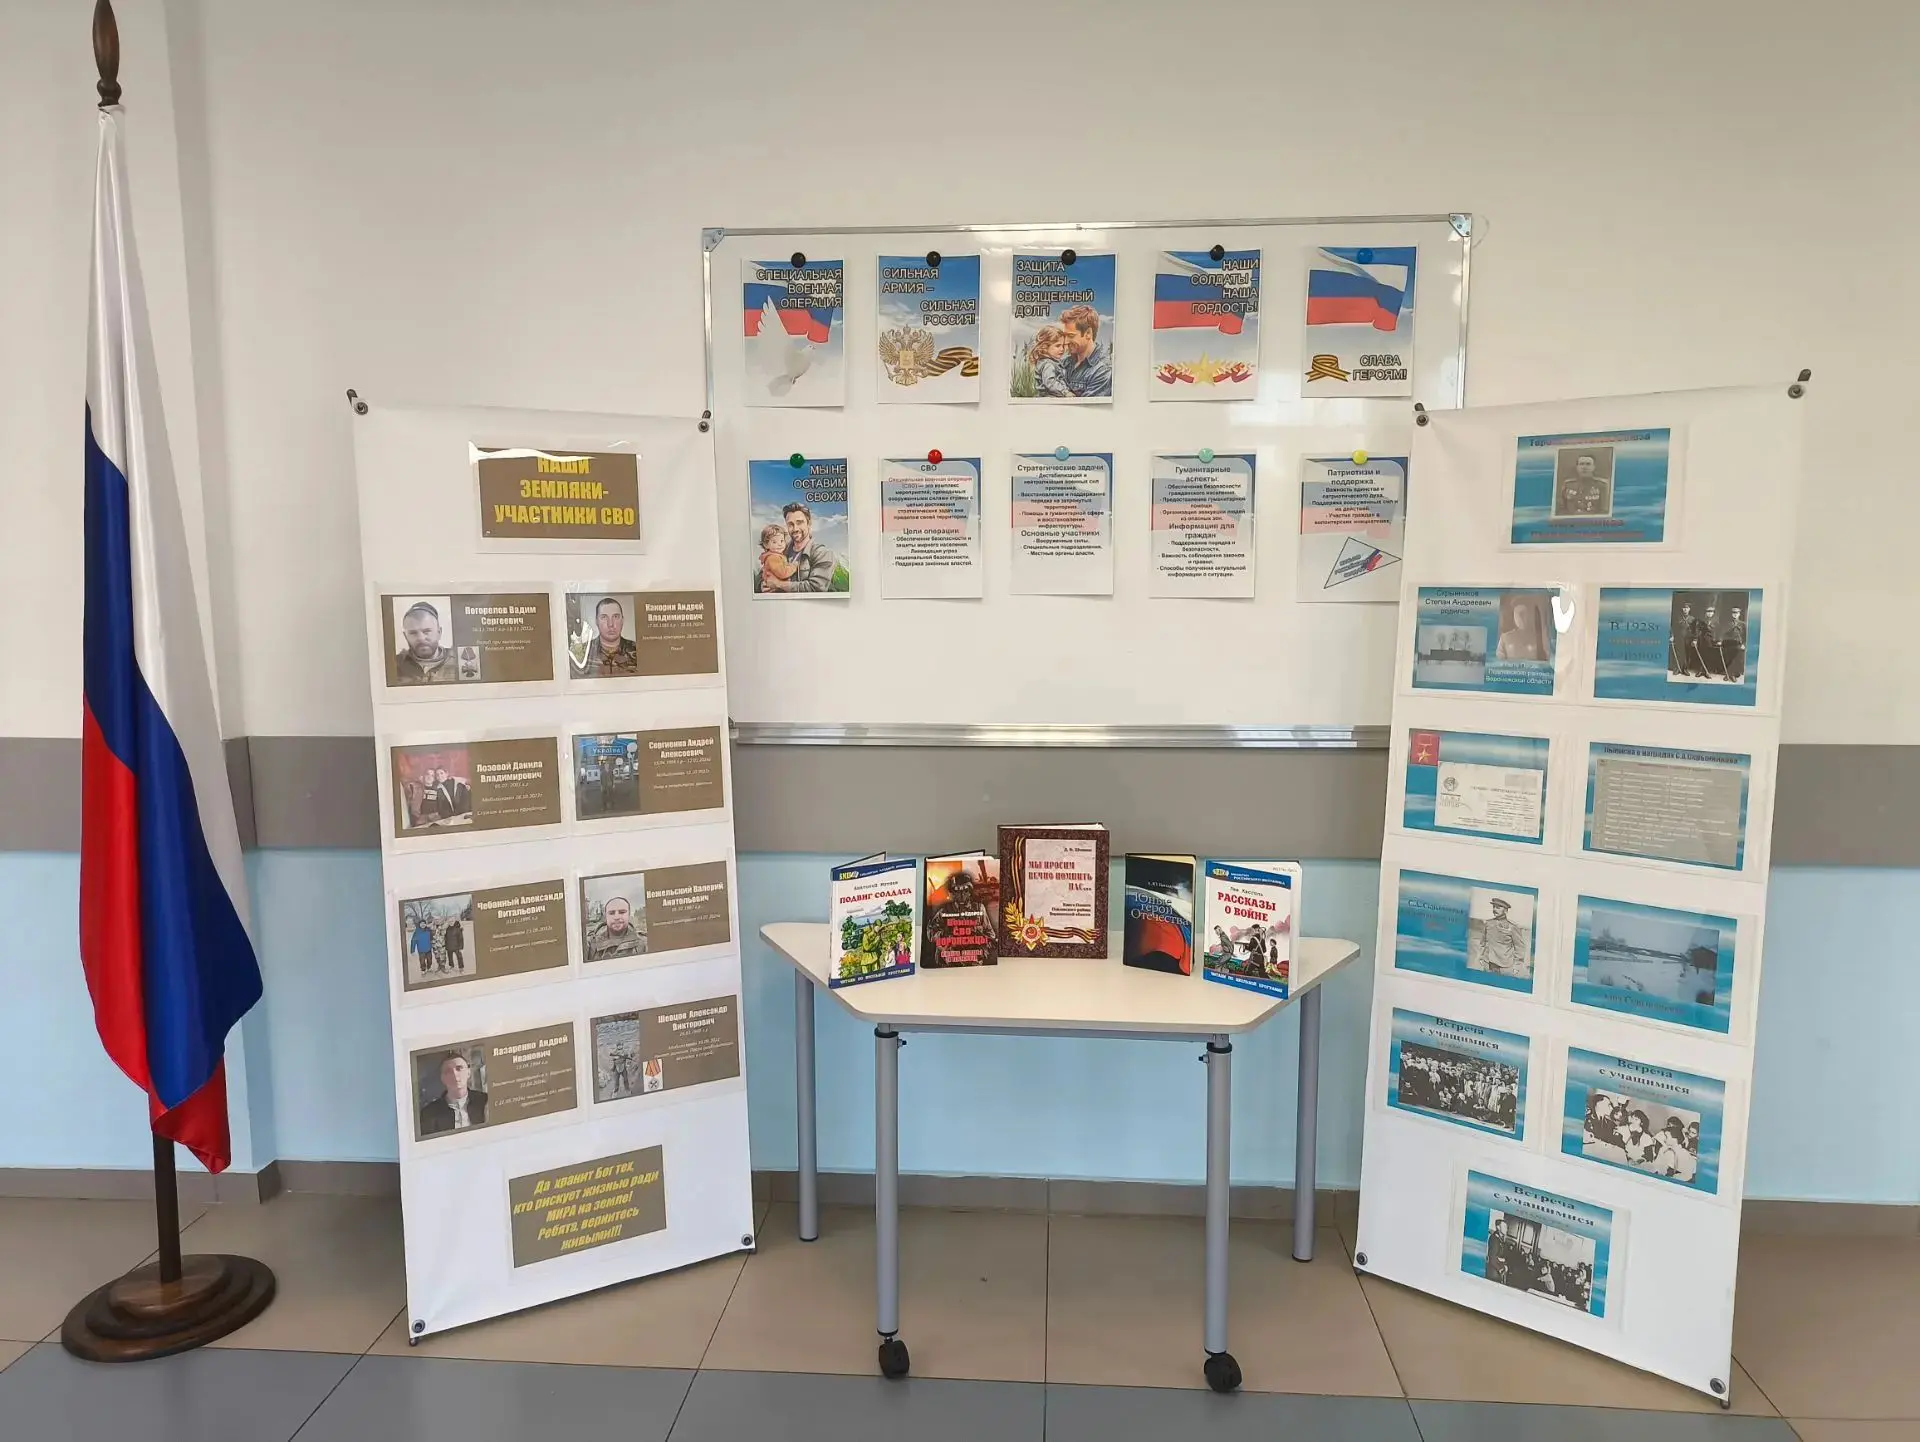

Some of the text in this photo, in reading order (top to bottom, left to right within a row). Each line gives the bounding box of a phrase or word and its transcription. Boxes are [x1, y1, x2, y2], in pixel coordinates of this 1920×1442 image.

[1017, 261, 1065, 273] ЗАЩИТА
[1222, 258, 1259, 270] НАШИ
[757, 268, 843, 280] СПЕЦИАЛЬНАЯ
[883, 268, 939, 280] СИЛЬНАЯ
[1191, 274, 1248, 286] СОЛДАТЫ
[1017, 275, 1068, 287] РОДИНЫ
[788, 283, 843, 295] ВОЕННАЯ
[882, 282, 923, 294] АРМИЯ
[1222, 287, 1258, 299] НАША
[1017, 289, 1094, 302] СВЯЩЕННЫЙ
[781, 297, 843, 309] ОПЕРАЦИЯ
[921, 300, 975, 311] СИЛЬНАЯ
[1191, 302, 1258, 314] ГОРДОСТЬ!
[1015, 305, 1049, 317] ДОЛГ!
[923, 314, 975, 326] РОССИЯ!
[1360, 354, 1401, 367] СЛАВА
[1353, 368, 1407, 381] ГЕРОЯМ!
[537, 457, 590, 473] НАШИ
[810, 465, 846, 475] МЫ НЕ
[1176, 466, 1230, 474] Гуманитарные
[1328, 469, 1374, 477] Патриотизм
[793, 478, 846, 488] ОСТАВИМ
[520, 480, 608, 499] ЗЕМЛЯКИ-
[806, 491, 846, 502] СВОИХ!
[494, 505, 634, 525] УЧАСТНИКИ СВО
[509, 606, 536, 614] Вадим
[648, 613, 702, 622] Владимирович
[688, 738, 713, 747] Андрей
[513, 761, 542, 771] Данила
[481, 772, 542, 782] Владимирович
[1029, 861, 1074, 869] МЫ ПРОСИМ
[521, 892, 563, 904] Александр
[840, 887, 912, 904] ПОДВИГ СОЛДАТА
[1135, 892, 1172, 905] Юные
[1218, 892, 1276, 911] РАССКАЗЫ
[1141, 904, 1173, 914] герои
[1225, 905, 1268, 922] О ВОЙНЕ
[1131, 908, 1189, 926] Отечества
[953, 927, 971, 935] СВО
[1436, 1018, 1484, 1035] Встреча
[539, 1035, 568, 1048] Андрей
[1428, 1029, 1499, 1050] учащимися
[1617, 1059, 1673, 1078] Встреча
[1599, 1068, 1606, 1076] с
[1610, 1071, 1689, 1094] учащимися
[534, 1180, 551, 1195] Да
[554, 1170, 594, 1189] хранит
[595, 1165, 613, 1179] Бог
[513, 1171, 659, 1216] кто рискует жизнью ради
[1514, 1186, 1575, 1209] Встреча
[546, 1191, 633, 1222] МИРА на земле!
[1504, 1195, 1594, 1226] учащимися
[538, 1208, 640, 1240] Ребята, вернитесь
